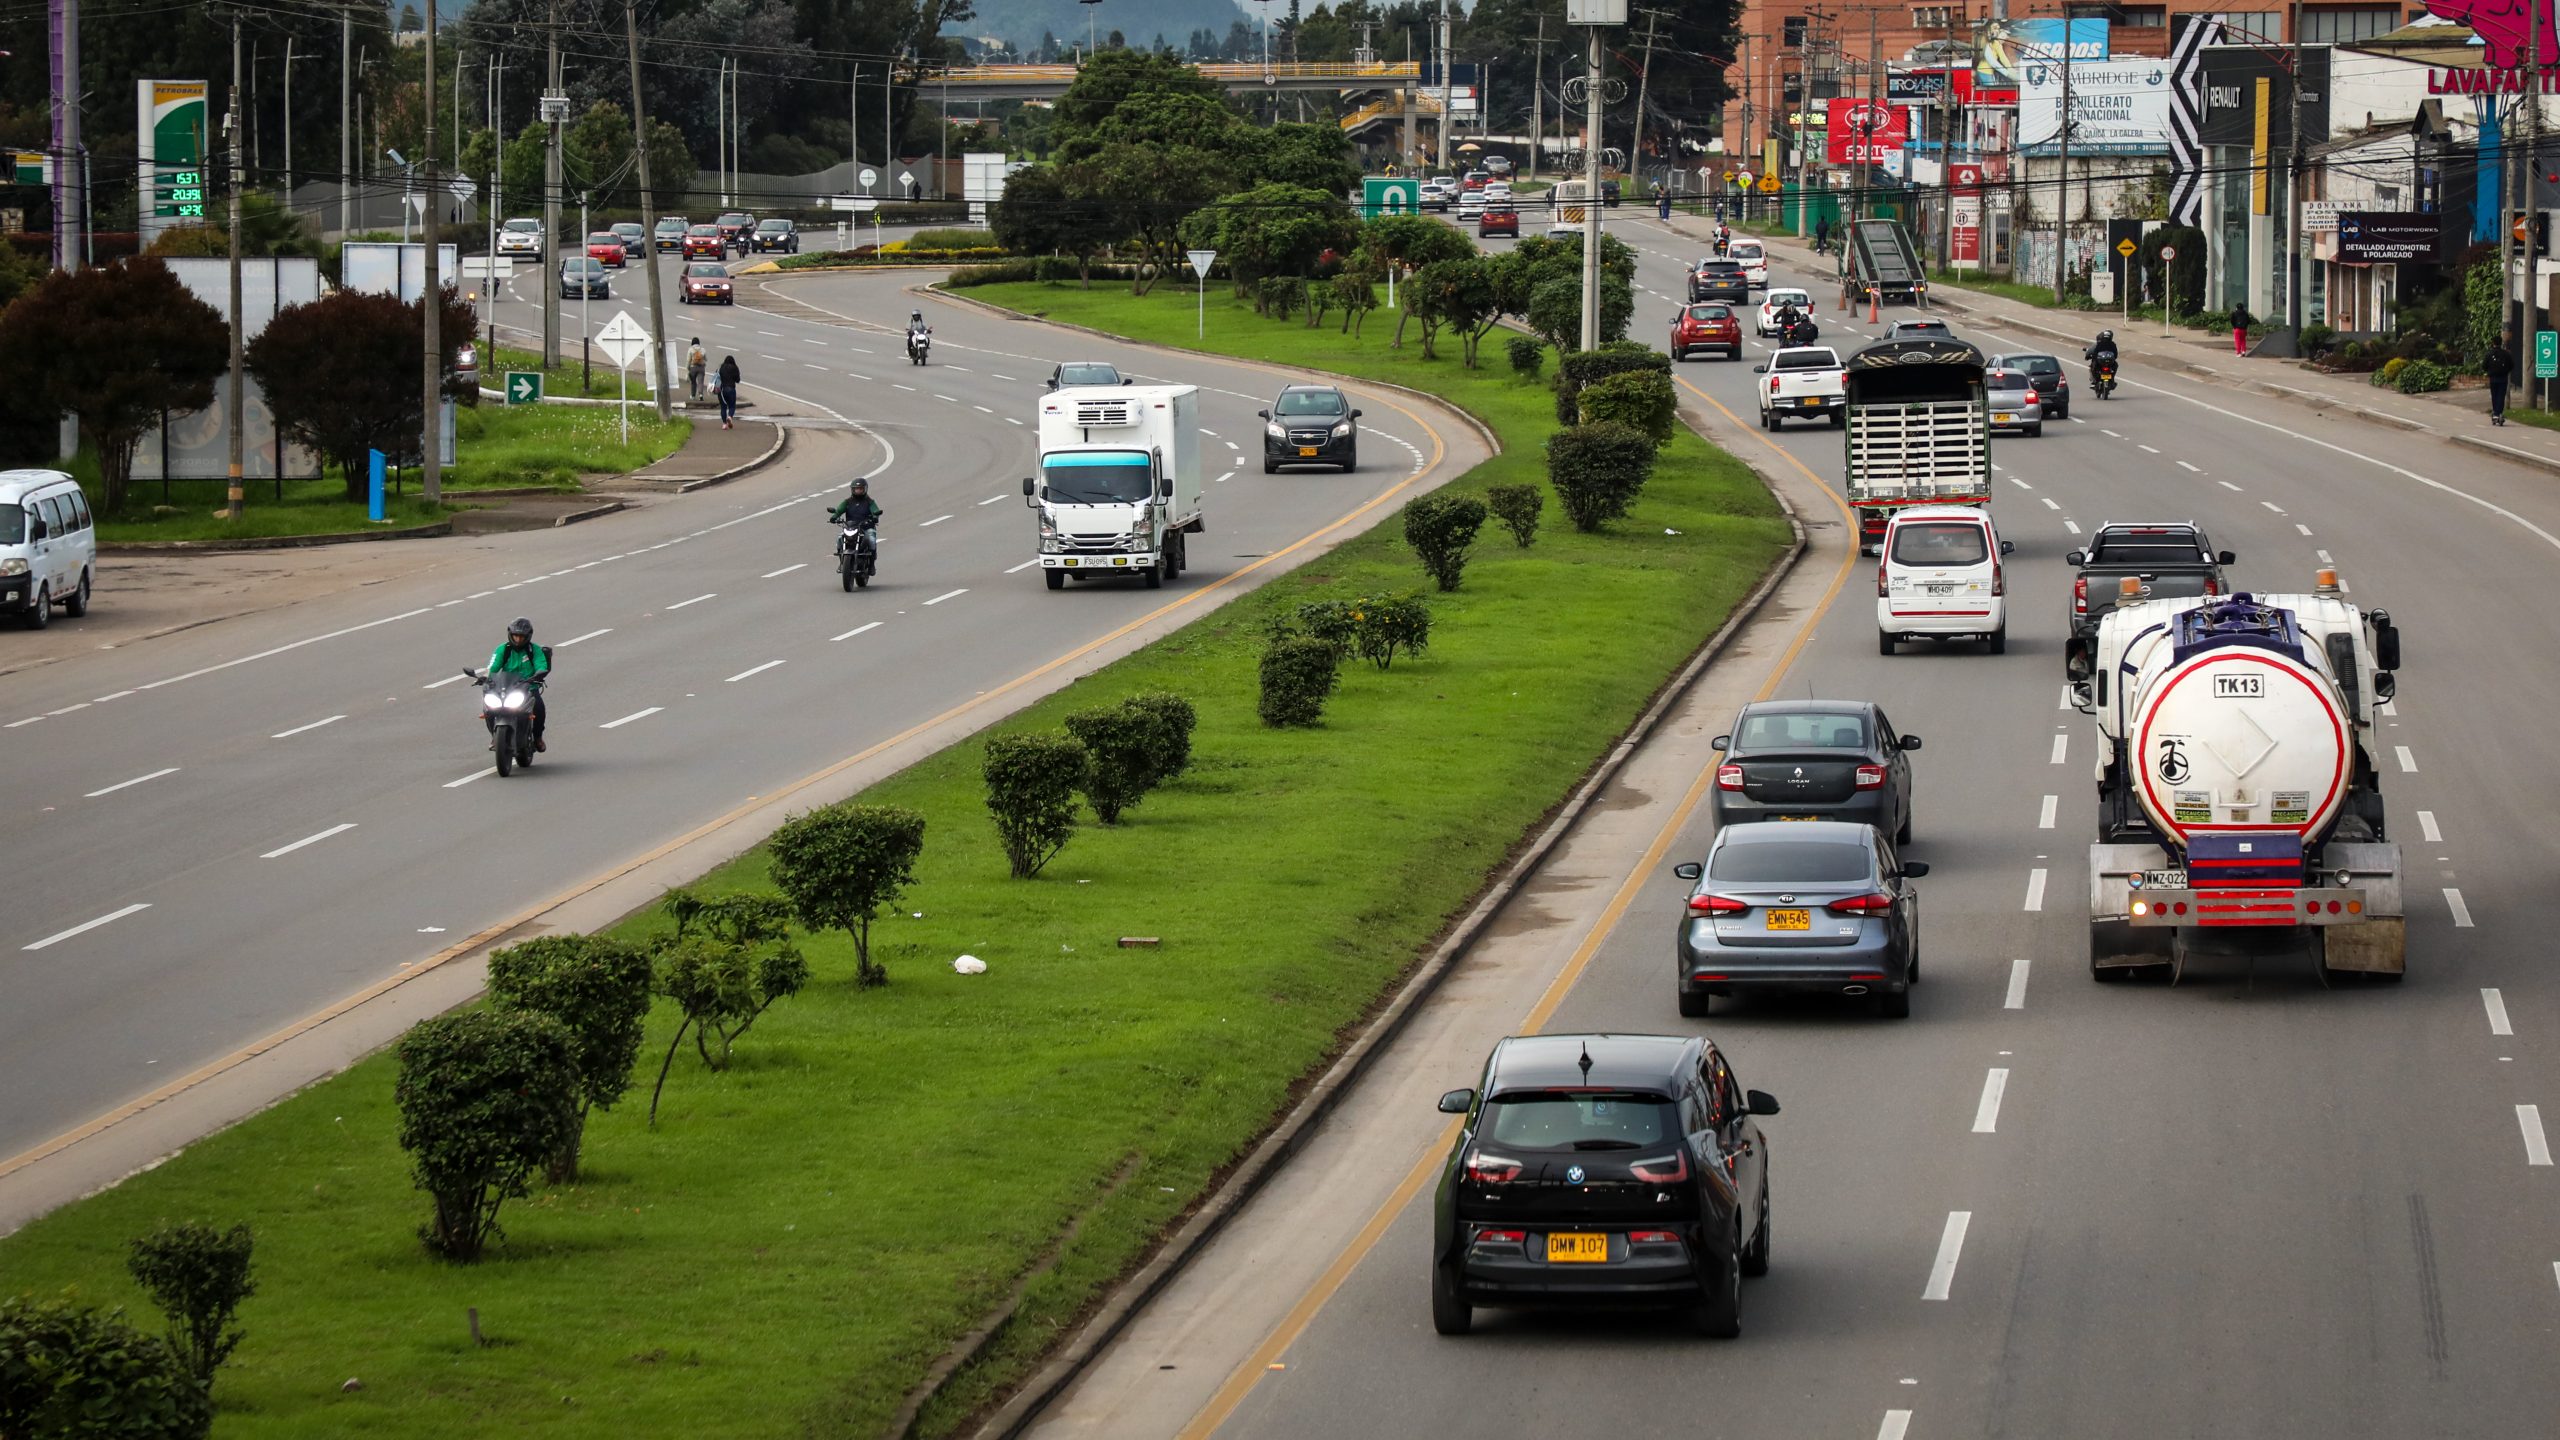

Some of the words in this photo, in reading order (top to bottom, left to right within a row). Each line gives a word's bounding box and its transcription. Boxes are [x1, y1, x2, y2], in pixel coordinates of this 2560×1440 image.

[2049, 72, 2138, 85] CMBRIDGE
[2056, 96, 2132, 108] BCHILLERATO
[2210, 86, 2240, 108] RENAULT
[2345, 243, 2385, 251] DETALLADO
[2541, 335, 2552, 343] Pr
[2543, 348, 2551, 359] 9
[2218, 678, 2259, 693] TK13
